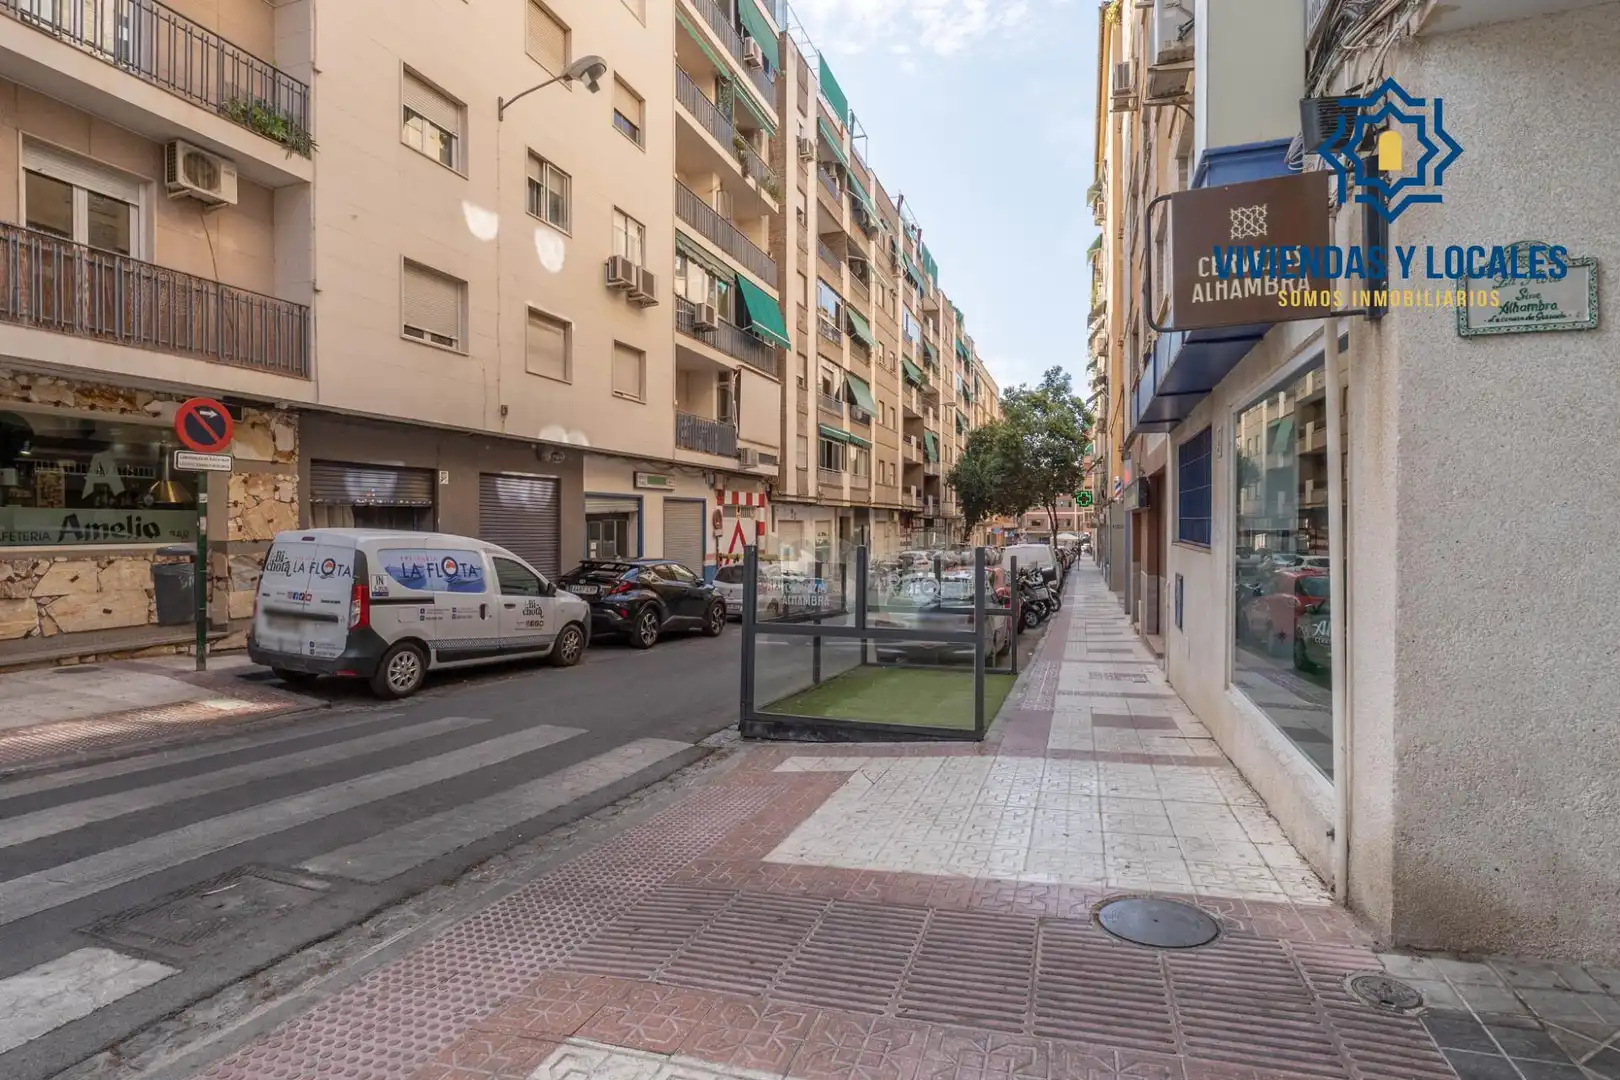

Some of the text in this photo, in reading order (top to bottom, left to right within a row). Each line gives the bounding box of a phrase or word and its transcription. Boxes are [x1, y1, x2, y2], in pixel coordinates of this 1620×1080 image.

[1192, 272, 1311, 303] ALHAMBRA
[1500, 299, 1558, 315] Alhambra
[0, 530, 51, 542] FETERIA
[57, 512, 161, 544] Amelio
[293, 558, 351, 578] LA FLOTA
[402, 556, 478, 580] LA FLOTA
